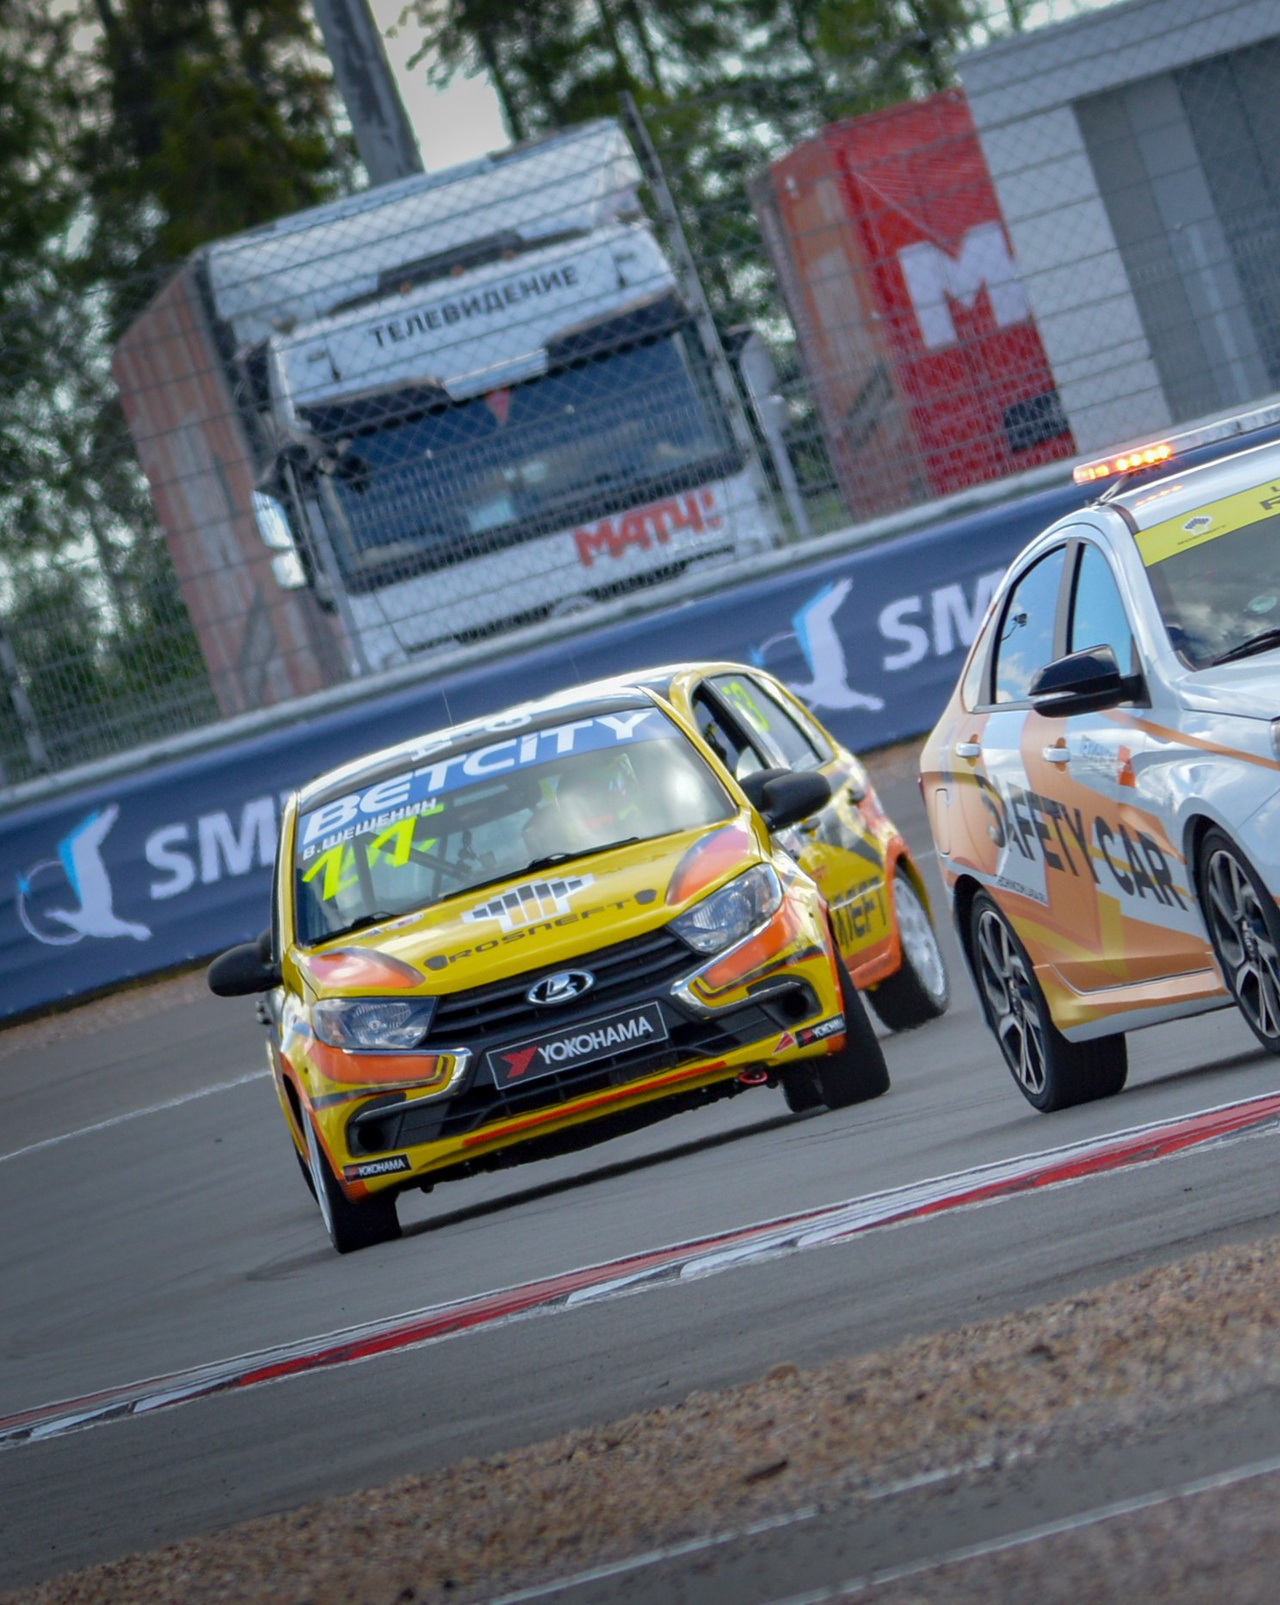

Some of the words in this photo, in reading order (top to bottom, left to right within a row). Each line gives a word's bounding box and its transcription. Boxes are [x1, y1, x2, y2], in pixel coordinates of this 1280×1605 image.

[370, 264, 579, 347] ТЕЛЕВИДЕНИЕ
[878, 568, 1007, 671] SM
[302, 708, 654, 846] BETCITY
[145, 789, 291, 900] SM
[302, 797, 437, 861] В.ШЕШЕНИН
[974, 773, 1101, 885] SAFETY
[1094, 815, 1190, 912] CAR
[447, 899, 633, 964] ROSNEFT
[536, 1015, 654, 1065] YOKOHAMA
[358, 1158, 407, 1177] YOKOHAMA
